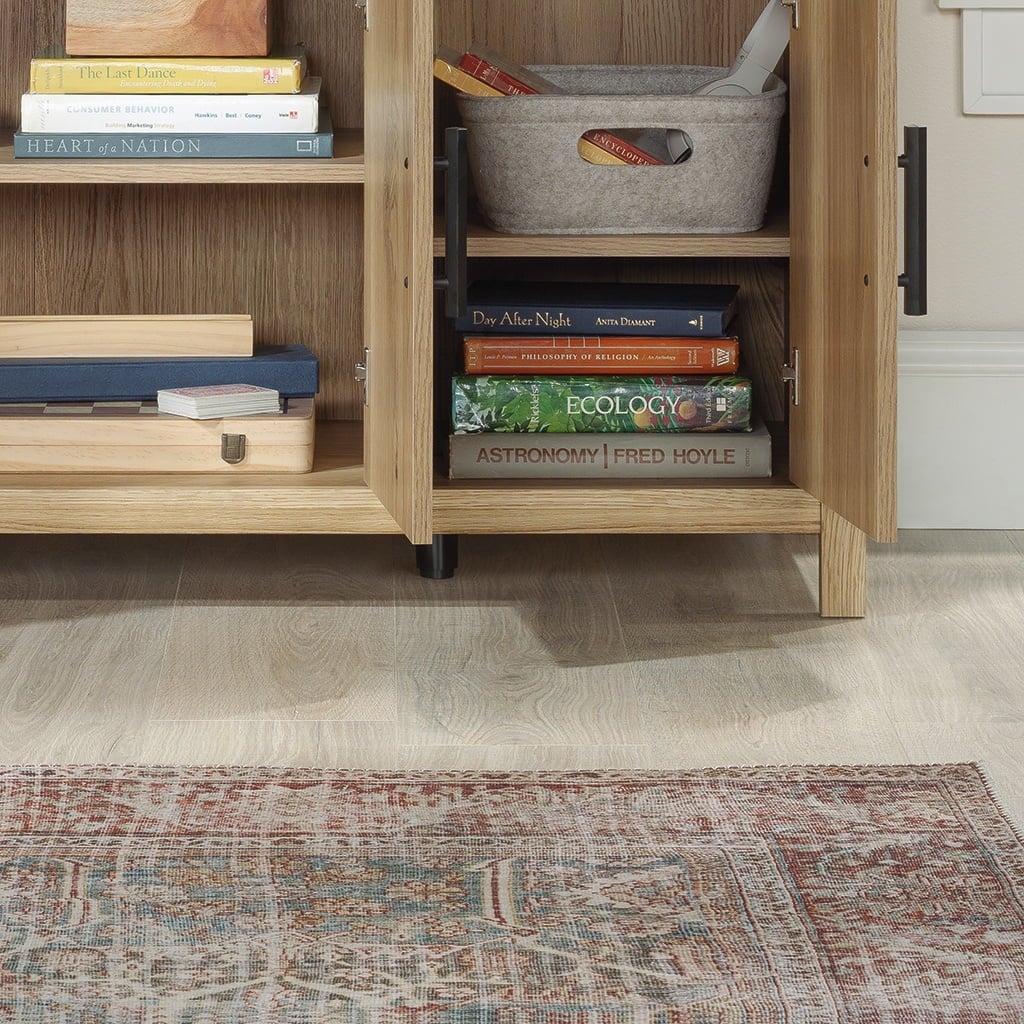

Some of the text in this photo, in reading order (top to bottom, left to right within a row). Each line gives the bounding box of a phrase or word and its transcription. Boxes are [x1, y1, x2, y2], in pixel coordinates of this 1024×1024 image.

[77, 66, 105, 79] The
[106, 66, 131, 79] Last
[137, 66, 177, 79] Dance
[67, 105, 175, 114] CONSUMER BEHAVIOR
[27, 139, 201, 153] HEART of a NATION
[473, 311, 571, 329] Day After Night
[595, 317, 656, 327] ANITA DIAMANT
[521, 353, 639, 361] PHILOSOPHY OF RELIGION
[566, 396, 680, 415] ECOLOGY
[476, 447, 598, 463] ASTRONOMY
[614, 448, 665, 464] FRED
[673, 449, 736, 465] HOYLE
